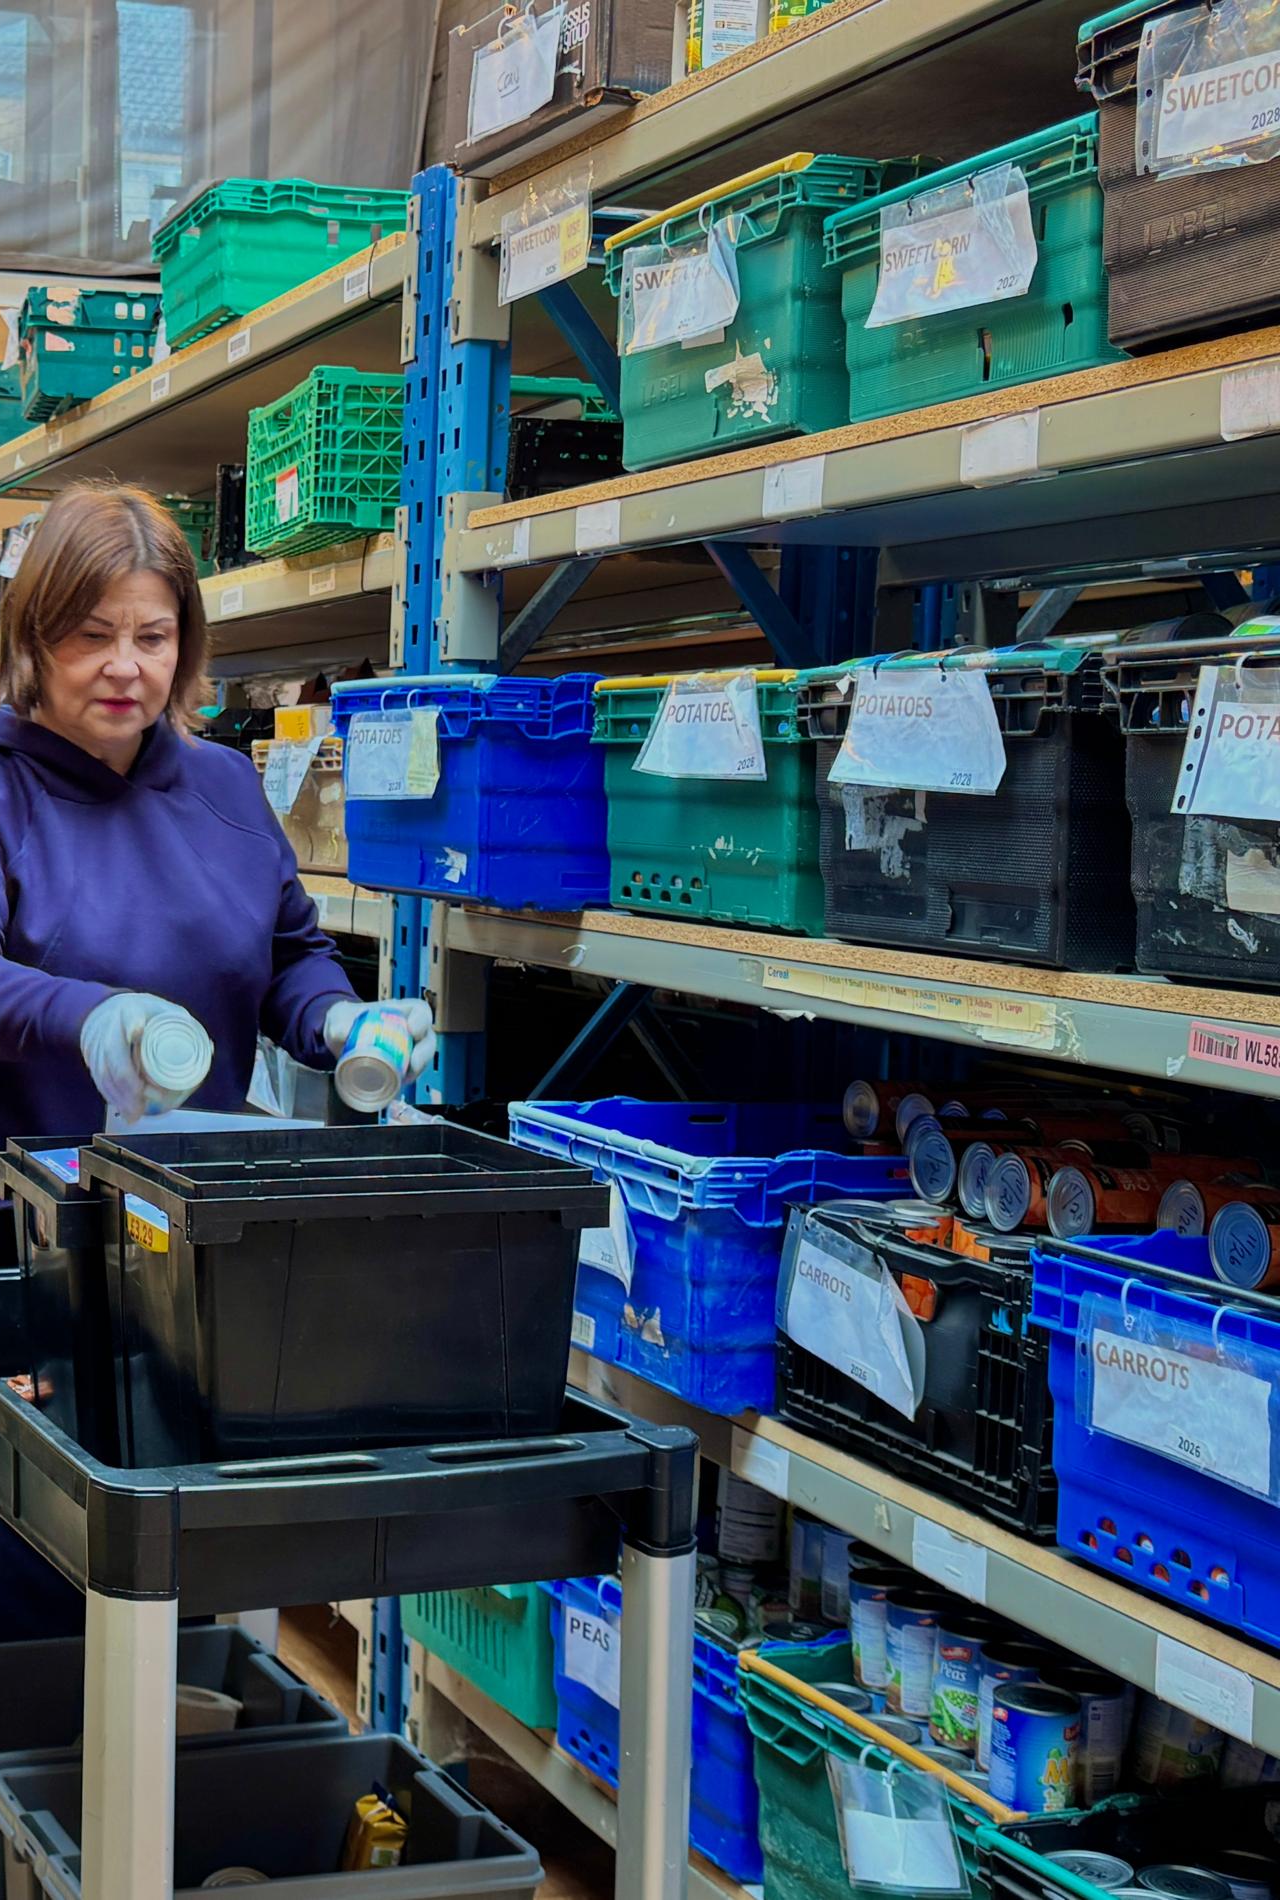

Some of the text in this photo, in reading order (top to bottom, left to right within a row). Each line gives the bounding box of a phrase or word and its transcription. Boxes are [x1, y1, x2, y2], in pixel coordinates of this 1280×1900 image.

[563, 21, 590, 54] group
[1251, 107, 1280, 131] 2028
[1144, 202, 1239, 256] LABEL
[885, 233, 971, 272] SWEETCORN
[634, 262, 714, 292] SWEET
[642, 373, 687, 408] LABEL
[666, 702, 735, 723] POTATOES
[856, 695, 932, 718] POTATOES
[353, 728, 402, 745] POTATOES
[950, 773, 972, 786] 2028
[767, 966, 790, 979] Cereal
[1004, 1003, 1023, 1014] Large
[1245, 1039, 1280, 1068] WL58
[1228, 1232, 1257, 1265] 11/26
[798, 1260, 852, 1302] CARROTS
[1096, 1341, 1190, 1390] CARROTS
[1178, 1436, 1201, 1458] 2026
[570, 1617, 610, 1652] PEAS
[940, 1662, 967, 1682] Peas
